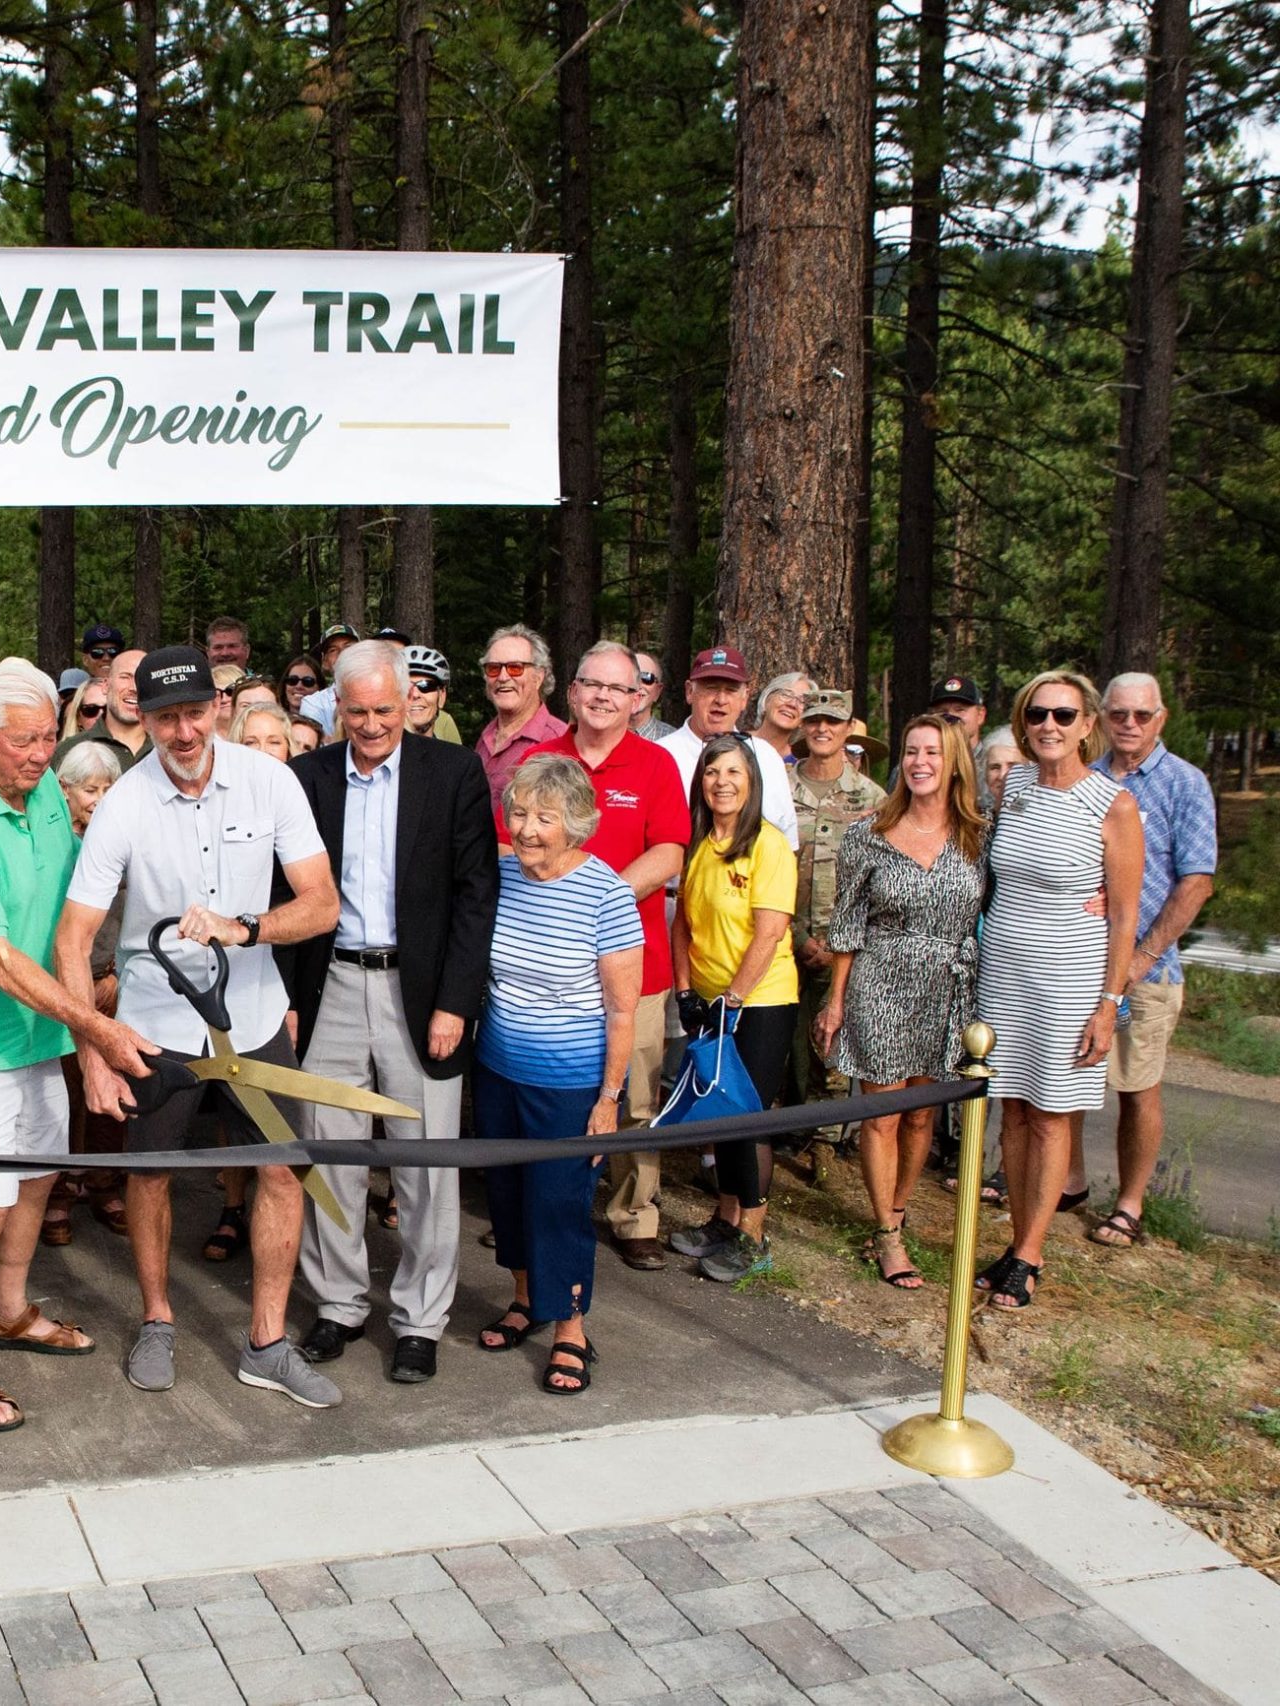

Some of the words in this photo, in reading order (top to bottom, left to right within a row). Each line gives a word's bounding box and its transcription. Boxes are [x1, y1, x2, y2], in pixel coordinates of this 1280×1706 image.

[303, 291, 516, 355] TRAIL
[50, 376, 323, 472] Opening
[151, 665, 197, 679] NORTHSTAR
[162, 674, 189, 685] C.S.D.
